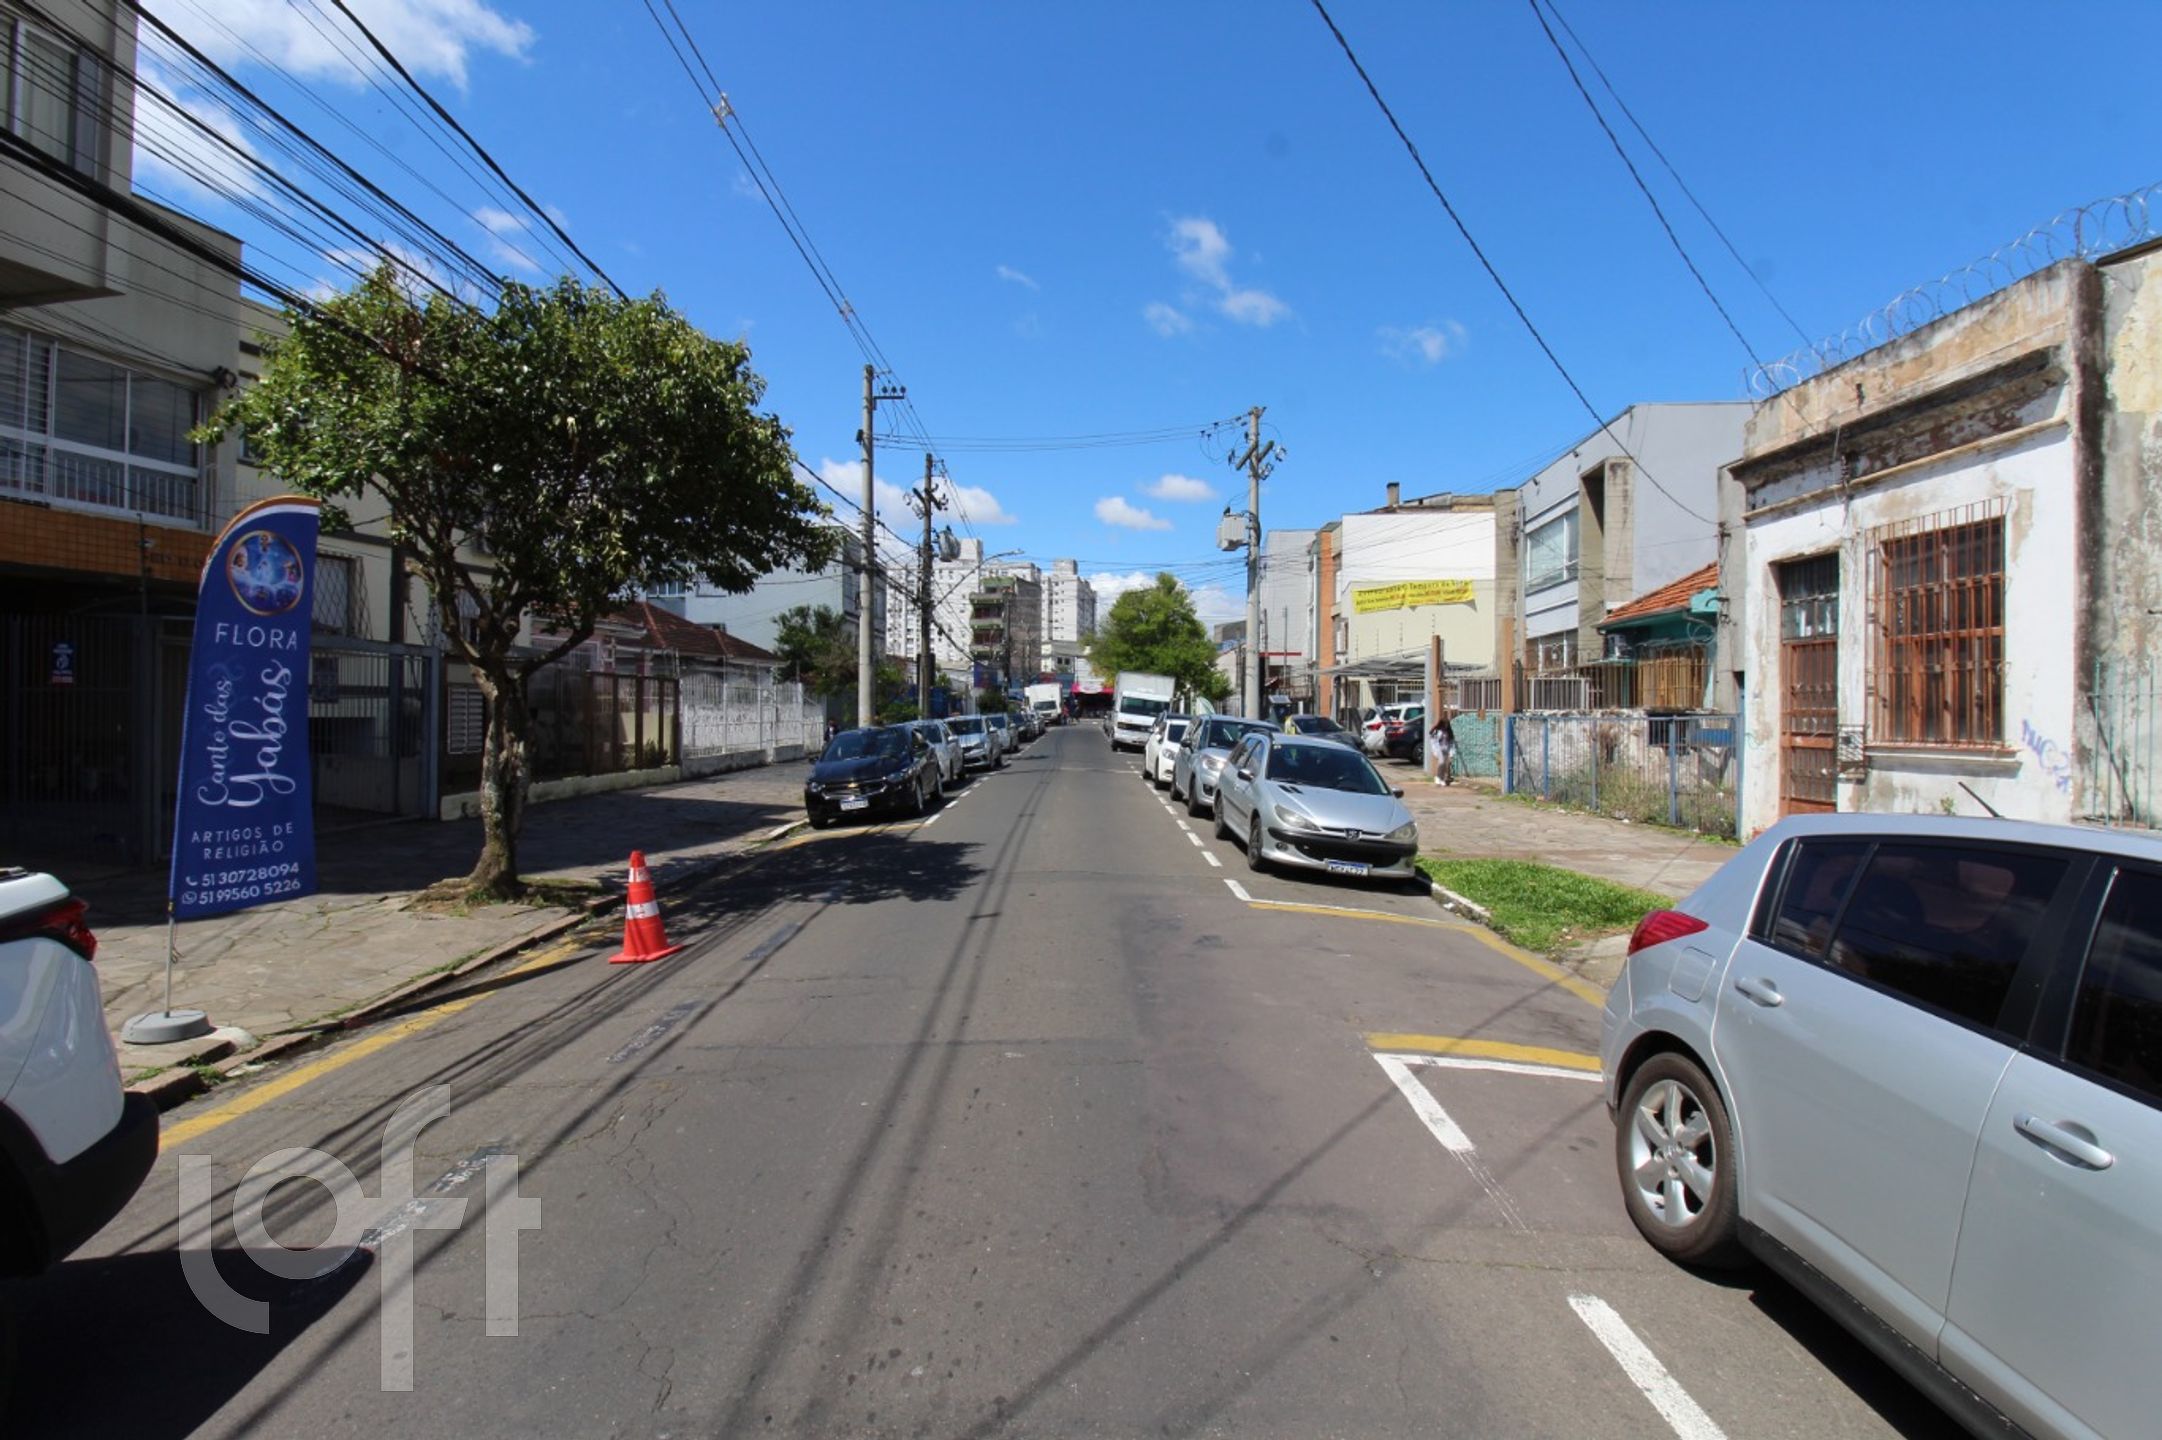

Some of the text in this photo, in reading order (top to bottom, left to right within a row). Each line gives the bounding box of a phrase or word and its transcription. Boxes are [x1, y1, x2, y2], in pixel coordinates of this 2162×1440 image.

[215, 622, 298, 650] FLORA
[197, 675, 233, 806] Canto das
[191, 821, 294, 843] ARTIGOS DE
[203, 839, 284, 860] RELIGIÃO
[263, 878, 301, 895] 5226
